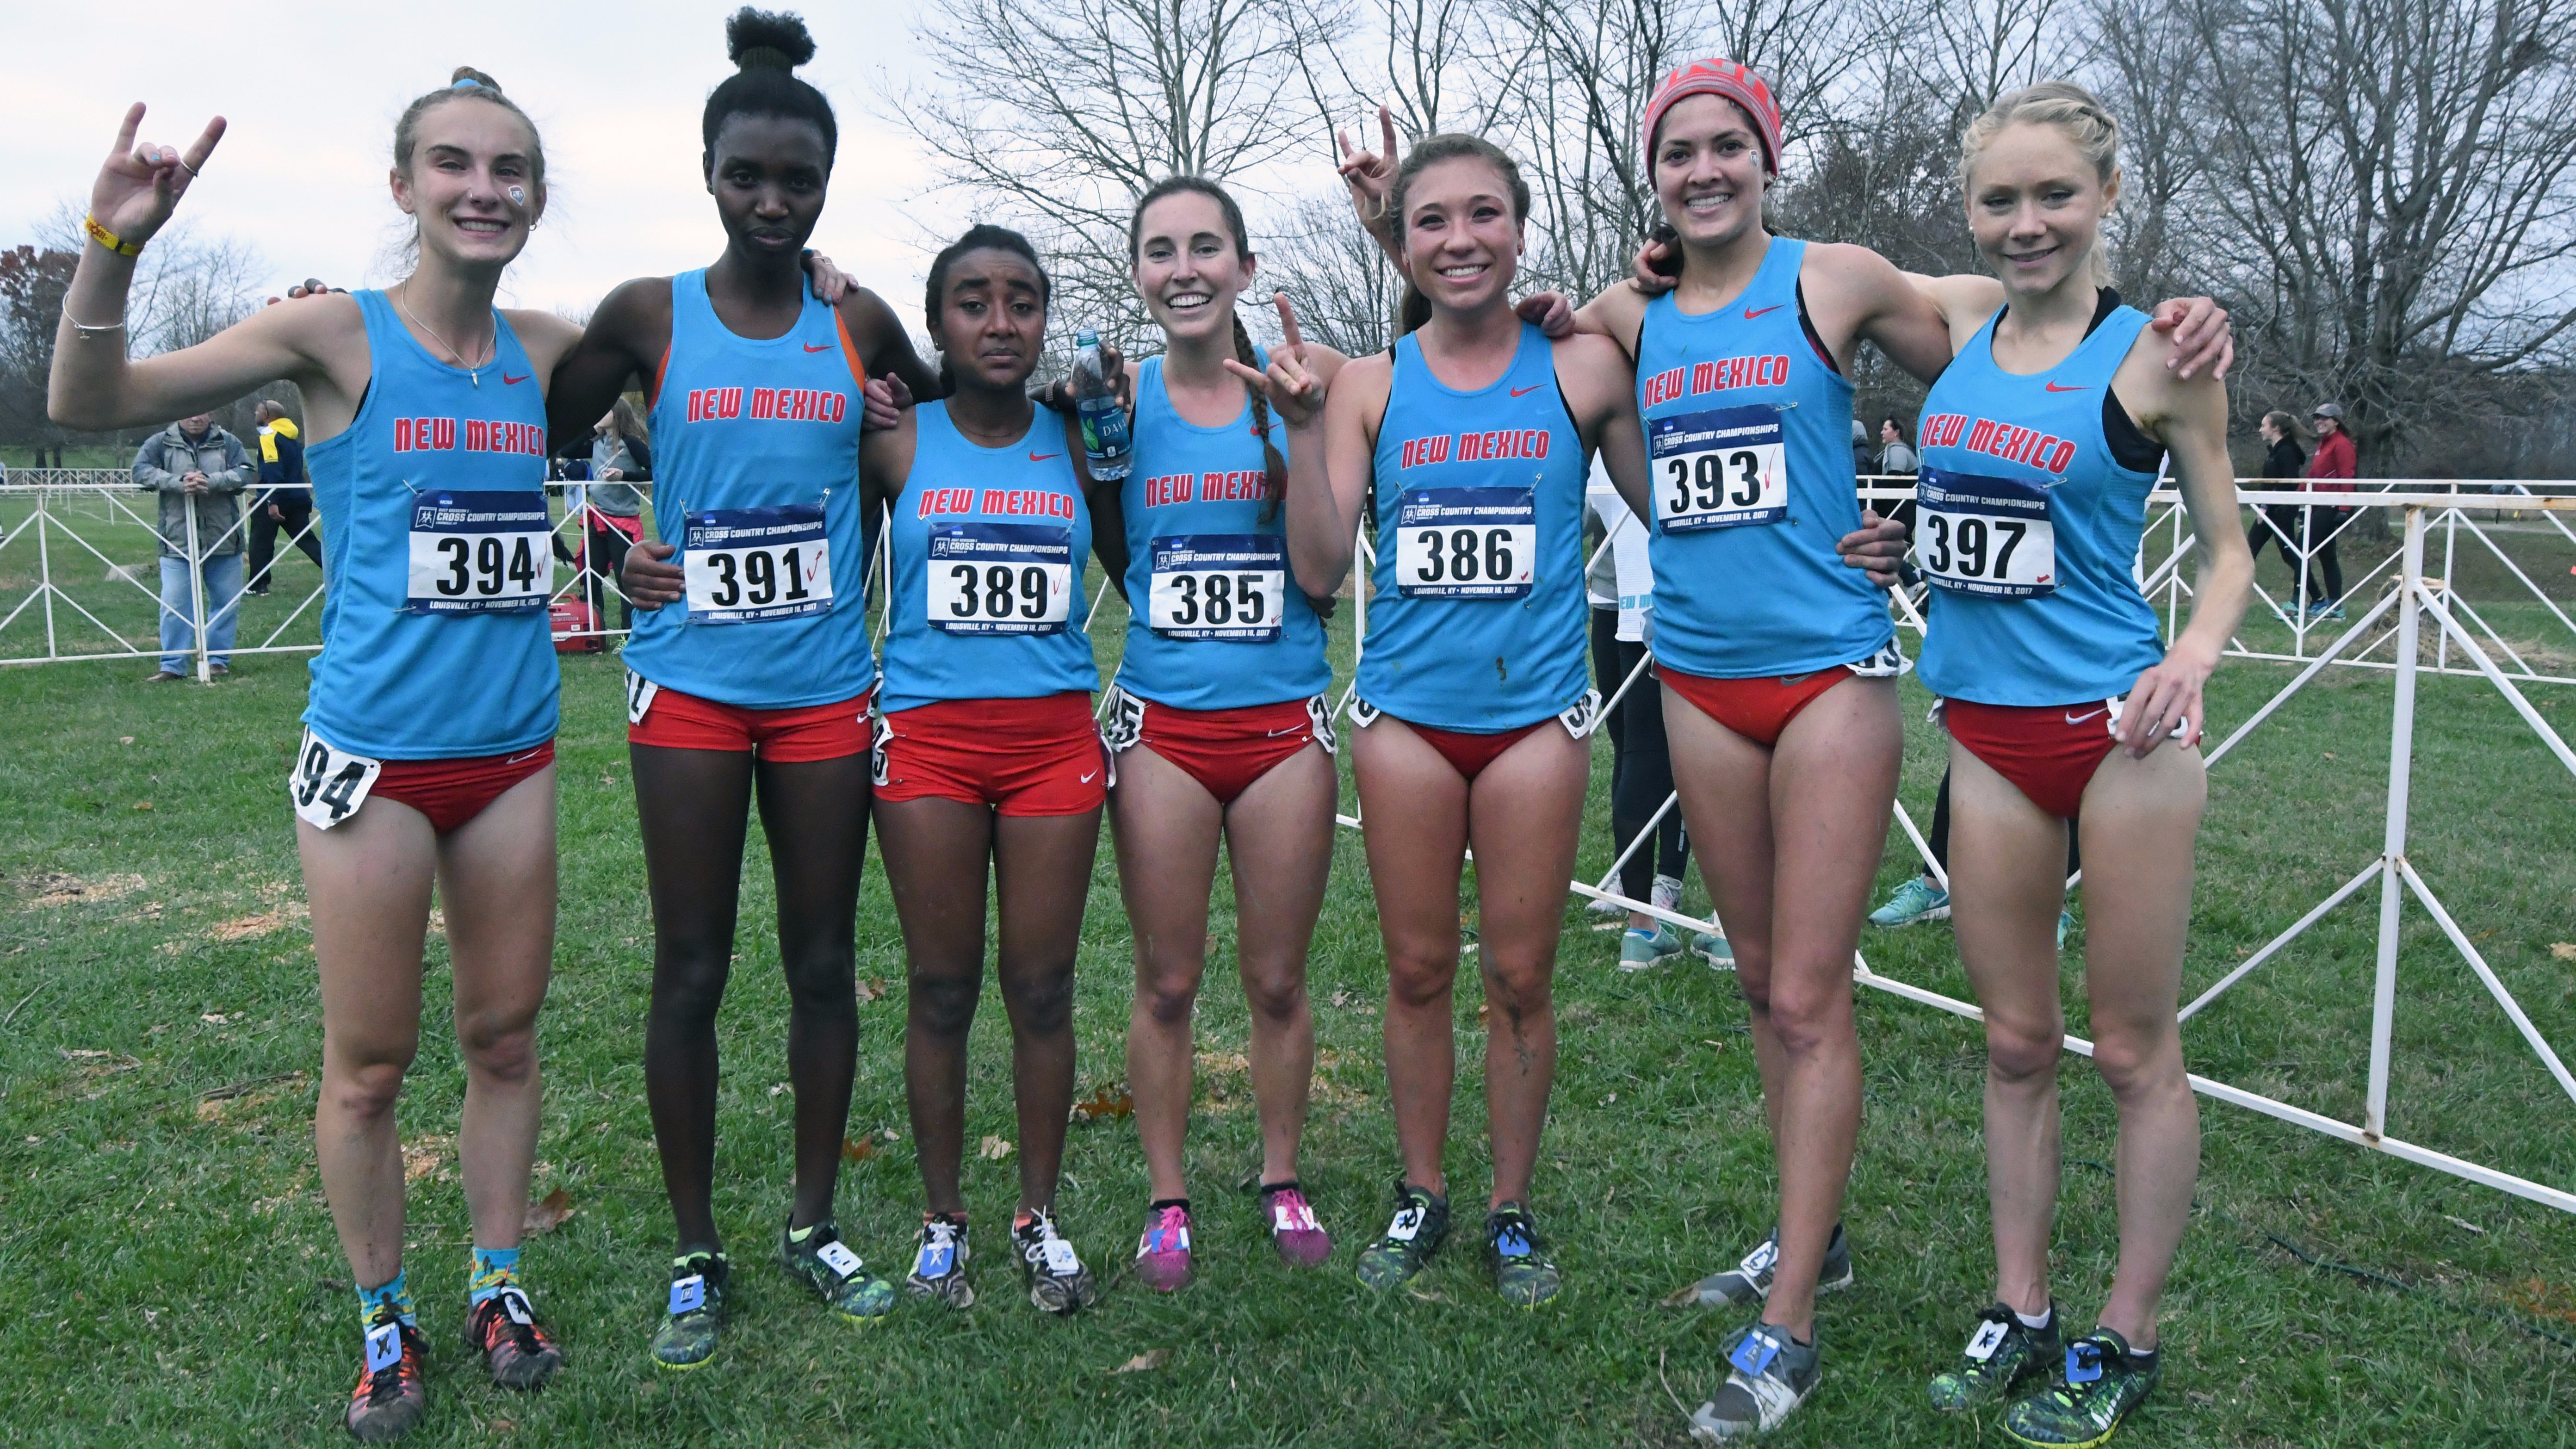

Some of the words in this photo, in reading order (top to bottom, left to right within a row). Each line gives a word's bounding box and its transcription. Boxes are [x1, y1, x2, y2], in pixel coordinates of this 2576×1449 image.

[1644, 366, 1685, 410] NEW
[1691, 355, 1790, 396] MEXICO
[687, 387, 743, 423] NEW
[750, 387, 846, 423] MEXICO
[395, 417, 456, 452] NEW
[465, 419, 545, 458] MEXICO
[1401, 434, 1451, 470] NEW
[1456, 429, 1550, 462] MEXICO
[1664, 435, 1683, 446] CROSS
[1684, 431, 1715, 443] COUNTRY
[1716, 424, 1778, 438] CHAMPIONSHIPS
[1920, 414, 1969, 448] NEW
[1966, 417, 2077, 475] MEXICO
[1146, 473, 1194, 509] NEW
[1201, 470, 1288, 502] MEXI
[1668, 451, 1760, 514] 393
[1927, 489, 1944, 501] CROSS
[1945, 493, 1979, 503] COUNTRY
[1981, 497, 2045, 510] CHAMPIONSHIPS
[436, 512, 466, 521] CROSS
[467, 513, 496, 522] COUNTRY
[497, 512, 545, 521] CHAMPIONSHIPS
[918, 488, 974, 518] NEW
[981, 489, 1074, 520] MEXICO
[1441, 507, 1473, 516] COUNTRY
[1474, 506, 1532, 515] CHAMPIONSHIPS
[1707, 513, 1742, 523] NOVEMBER
[1753, 511, 1769, 519] 2017
[705, 530, 729, 539] CROSS
[730, 527, 765, 538] COUNTRY
[767, 521, 823, 536] CHAMPIONSHIPS
[1928, 514, 2027, 579] 397
[975, 543, 1009, 552] COUNTRY
[1009, 544, 1068, 554] CHAMPIONSHIPS
[1171, 553, 1192, 563] CROSS
[1194, 553, 1226, 561] COUNTRY
[1418, 529, 1512, 582] 386
[436, 537, 535, 595] 394
[708, 547, 808, 607] 391
[485, 600, 518, 608] NOVEMBER
[950, 564, 1047, 619] 389
[1171, 574, 1264, 625] 385
[1620, 595, 1635, 609] EW
[1968, 583, 2003, 594] NOVEMBER
[760, 606, 793, 618] NOVEMBER
[803, 603, 817, 612] 2017
